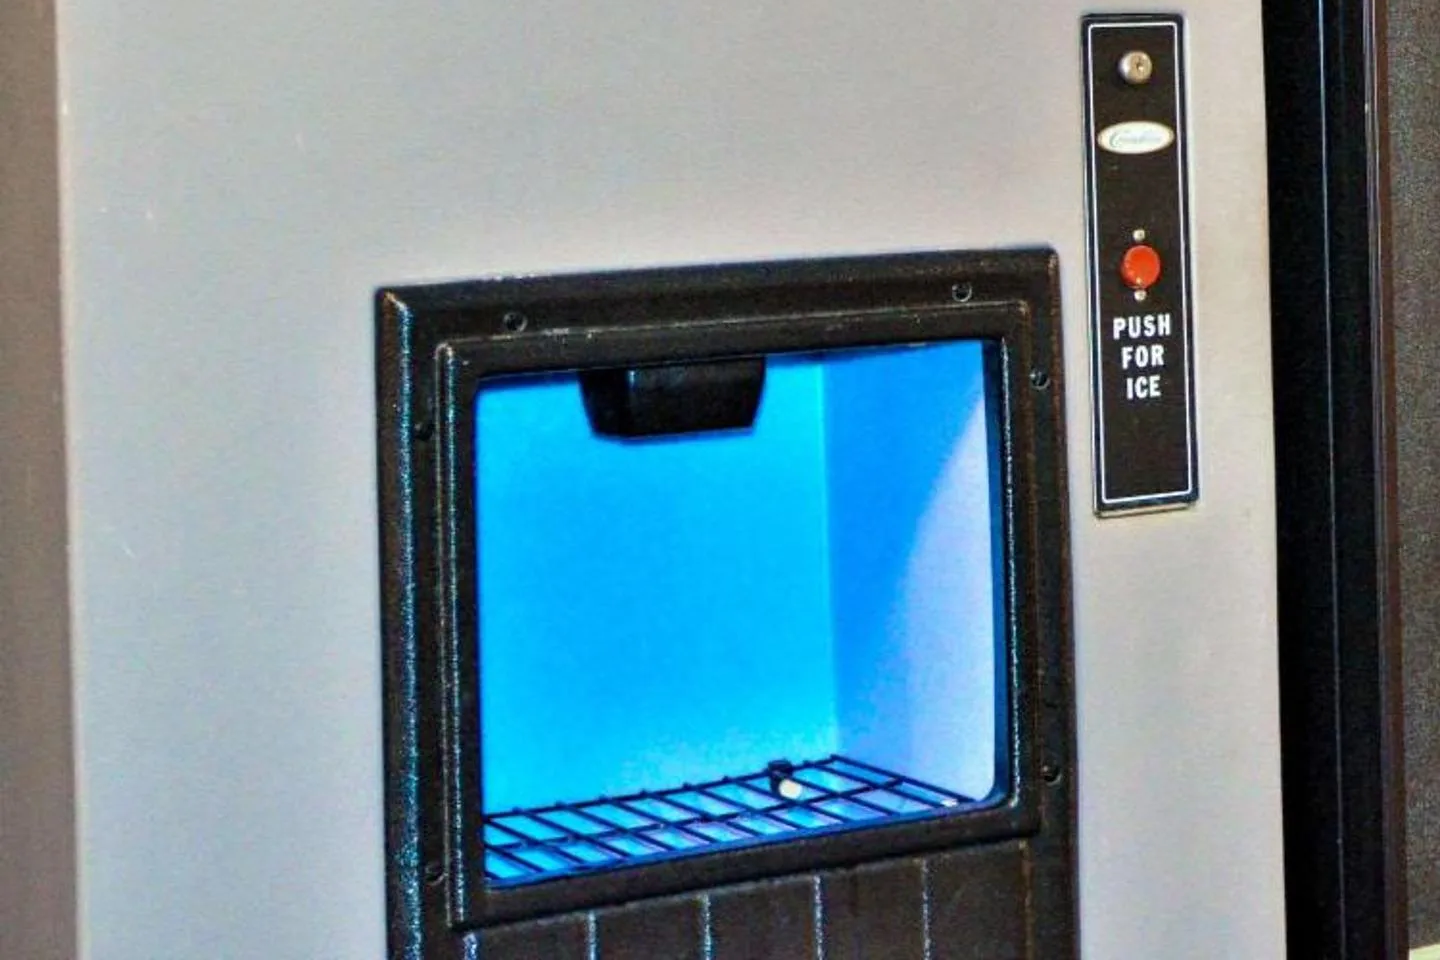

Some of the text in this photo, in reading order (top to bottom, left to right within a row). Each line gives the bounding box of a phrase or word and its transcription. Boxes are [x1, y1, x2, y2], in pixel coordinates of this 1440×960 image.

[1113, 313, 1171, 341] PUSH
[1121, 344, 1165, 370] FOR
[1126, 374, 1162, 400] ICE
